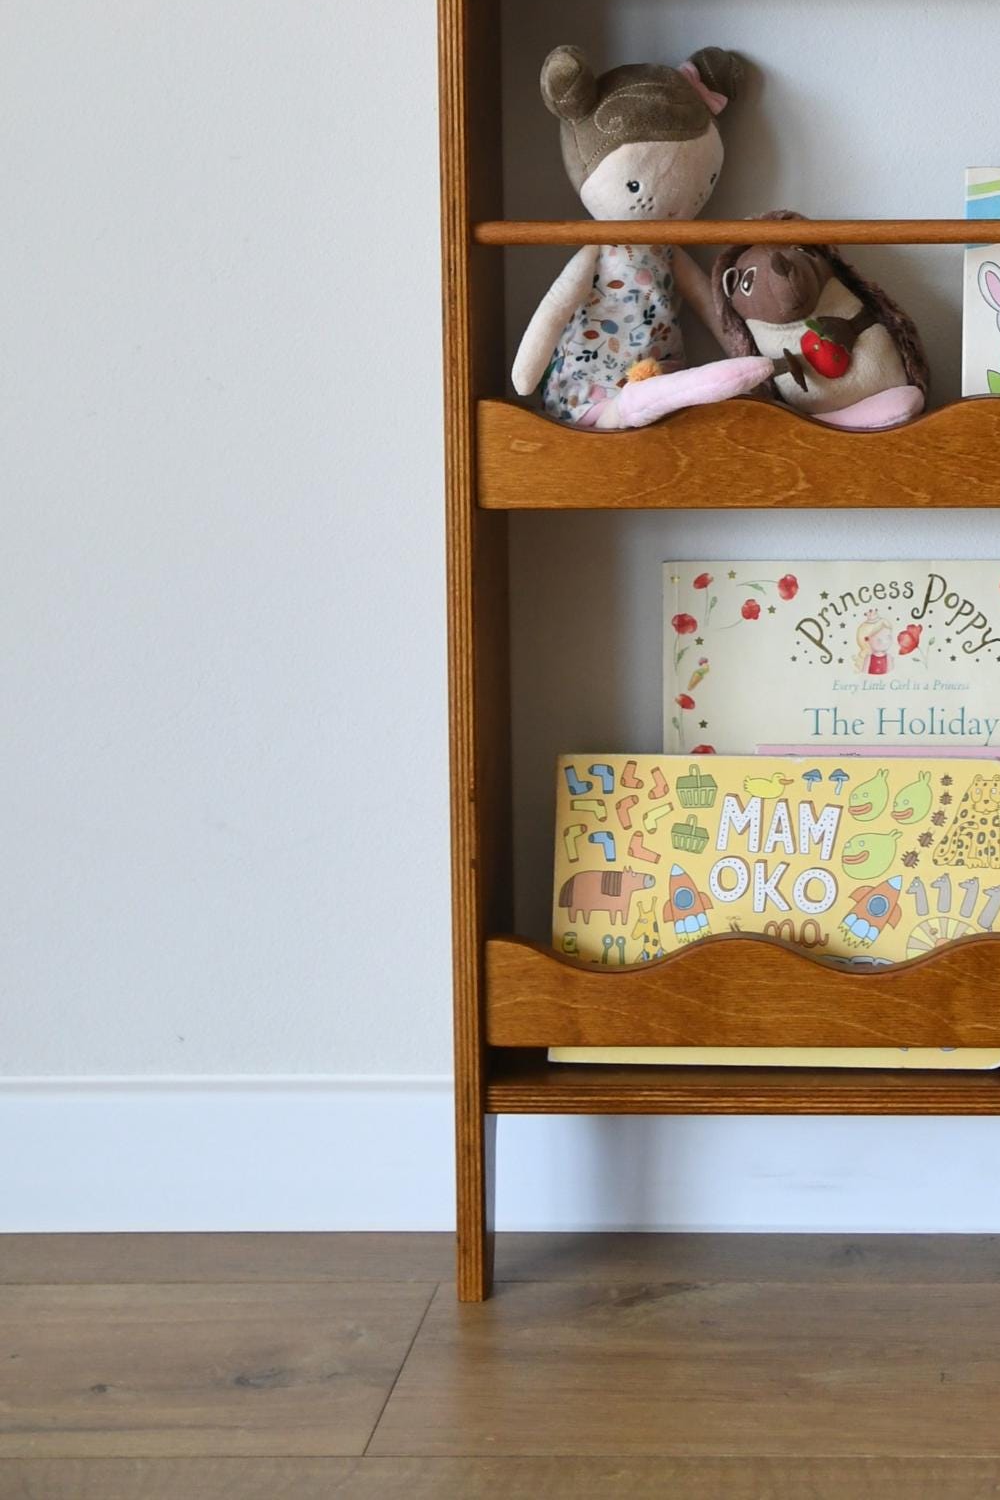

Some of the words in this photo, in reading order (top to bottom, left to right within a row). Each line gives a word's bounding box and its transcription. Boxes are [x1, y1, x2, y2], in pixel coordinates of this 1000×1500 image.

[795, 580, 914, 665] Princess
[832, 679, 859, 694] Every
[862, 679, 886, 691] Little
[889, 678, 911, 691] Girl
[803, 706, 865, 737] The
[876, 706, 1000, 747] Holiday
[715, 792, 844, 861] MAM
[708, 855, 839, 915] OKO
